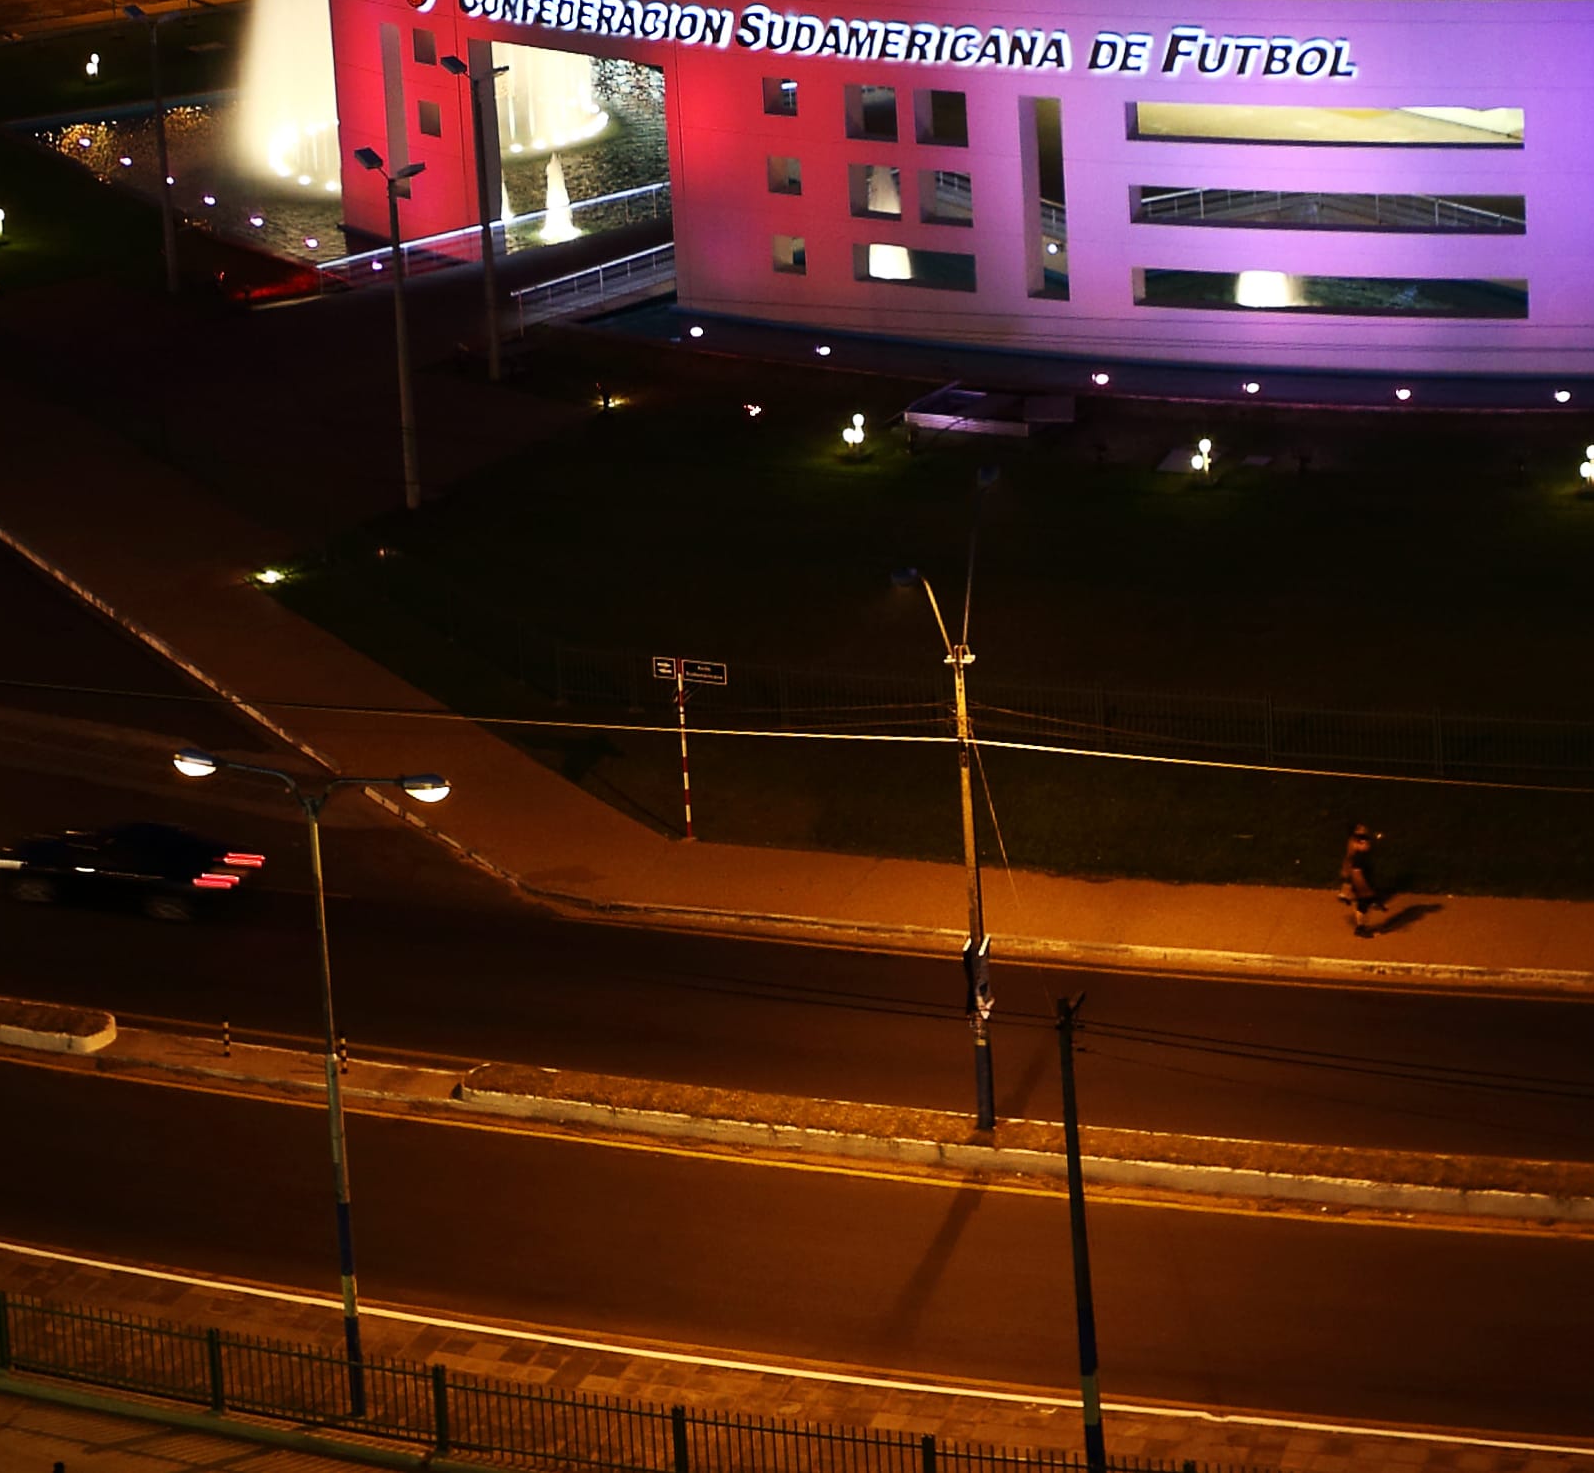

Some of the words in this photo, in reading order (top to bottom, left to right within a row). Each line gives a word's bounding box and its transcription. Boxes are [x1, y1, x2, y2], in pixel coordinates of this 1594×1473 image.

[736, 3, 1073, 72] SUDAMERICANA
[1088, 31, 1153, 74] DE
[1161, 25, 1359, 78] FUTBOL
